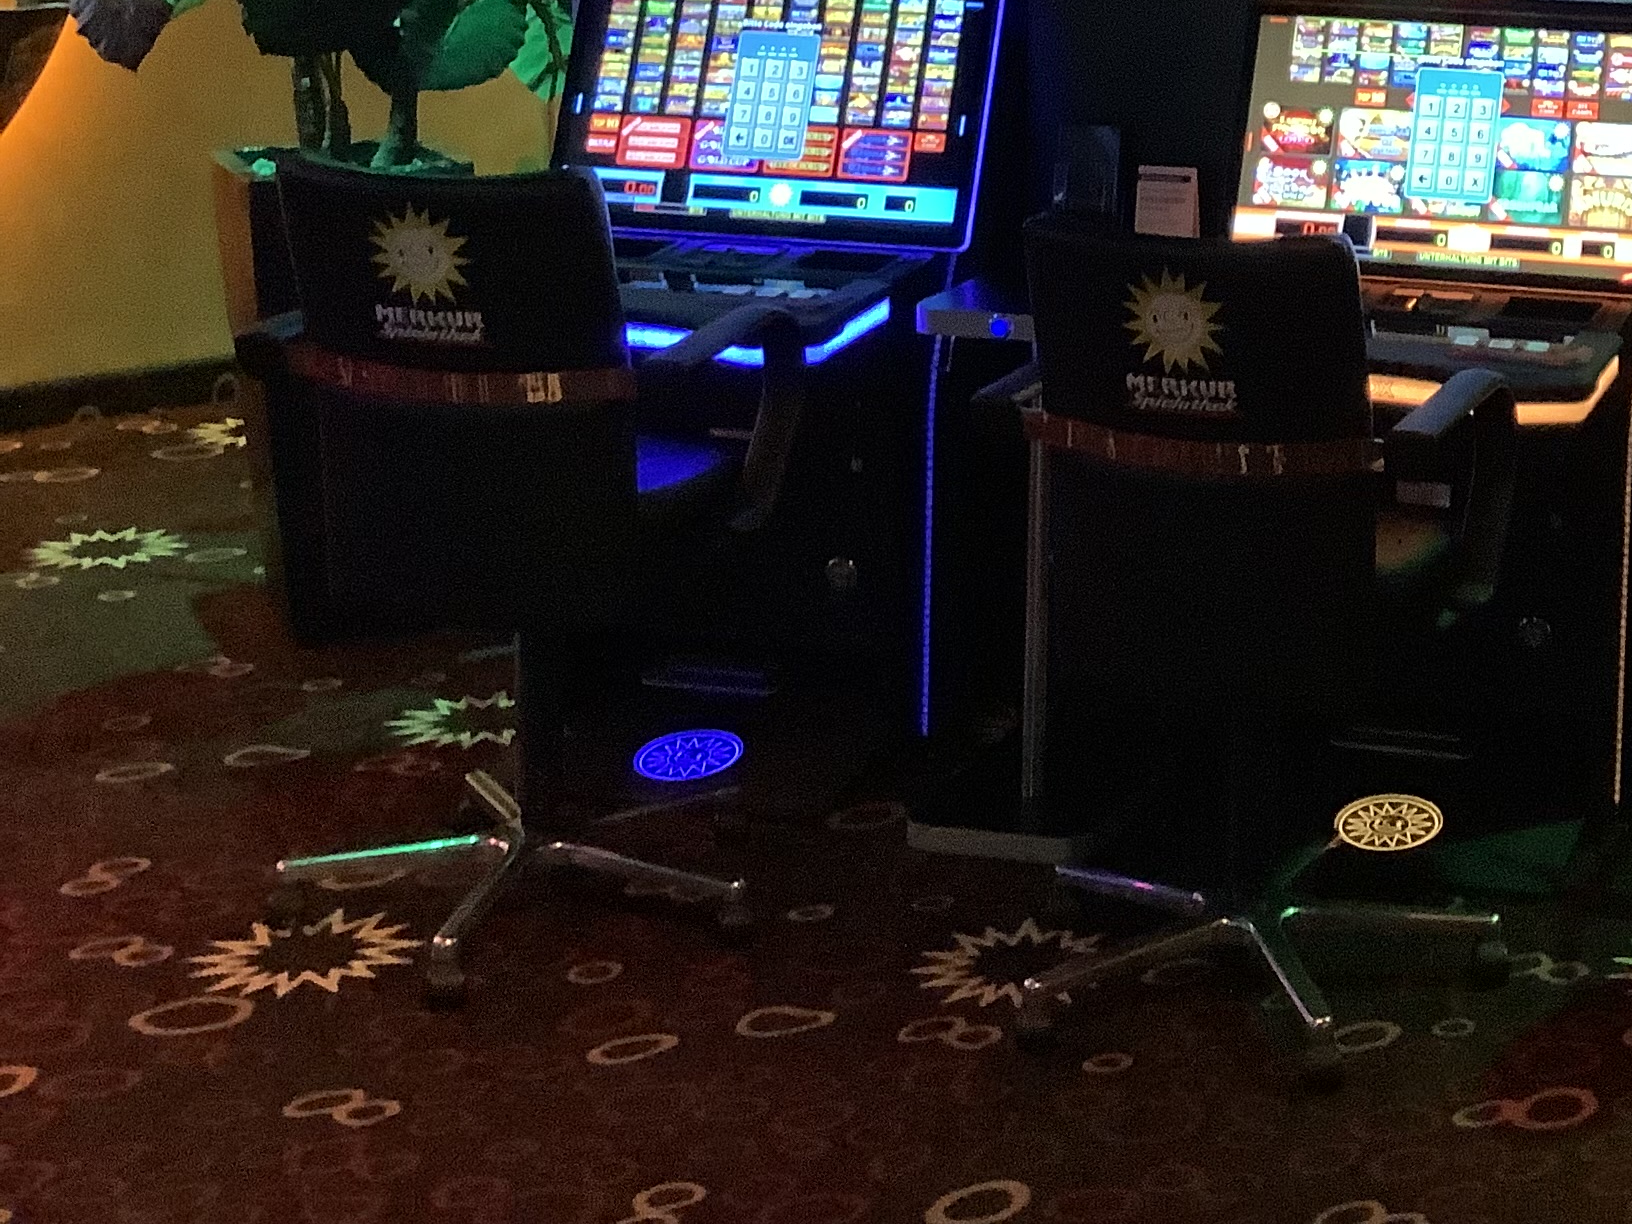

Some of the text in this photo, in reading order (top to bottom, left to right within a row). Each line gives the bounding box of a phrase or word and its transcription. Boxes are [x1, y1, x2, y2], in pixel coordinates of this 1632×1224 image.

[783, 135, 795, 145] OK
[750, 190, 759, 203] 0
[856, 197, 866, 209] 0
[904, 200, 914, 213] 0
[1436, 233, 1447, 247] 0
[1551, 241, 1562, 256] 0
[1603, 245, 1614, 259] 0
[375, 304, 485, 327] MERKUR
[1126, 372, 1237, 398] MERKUR
